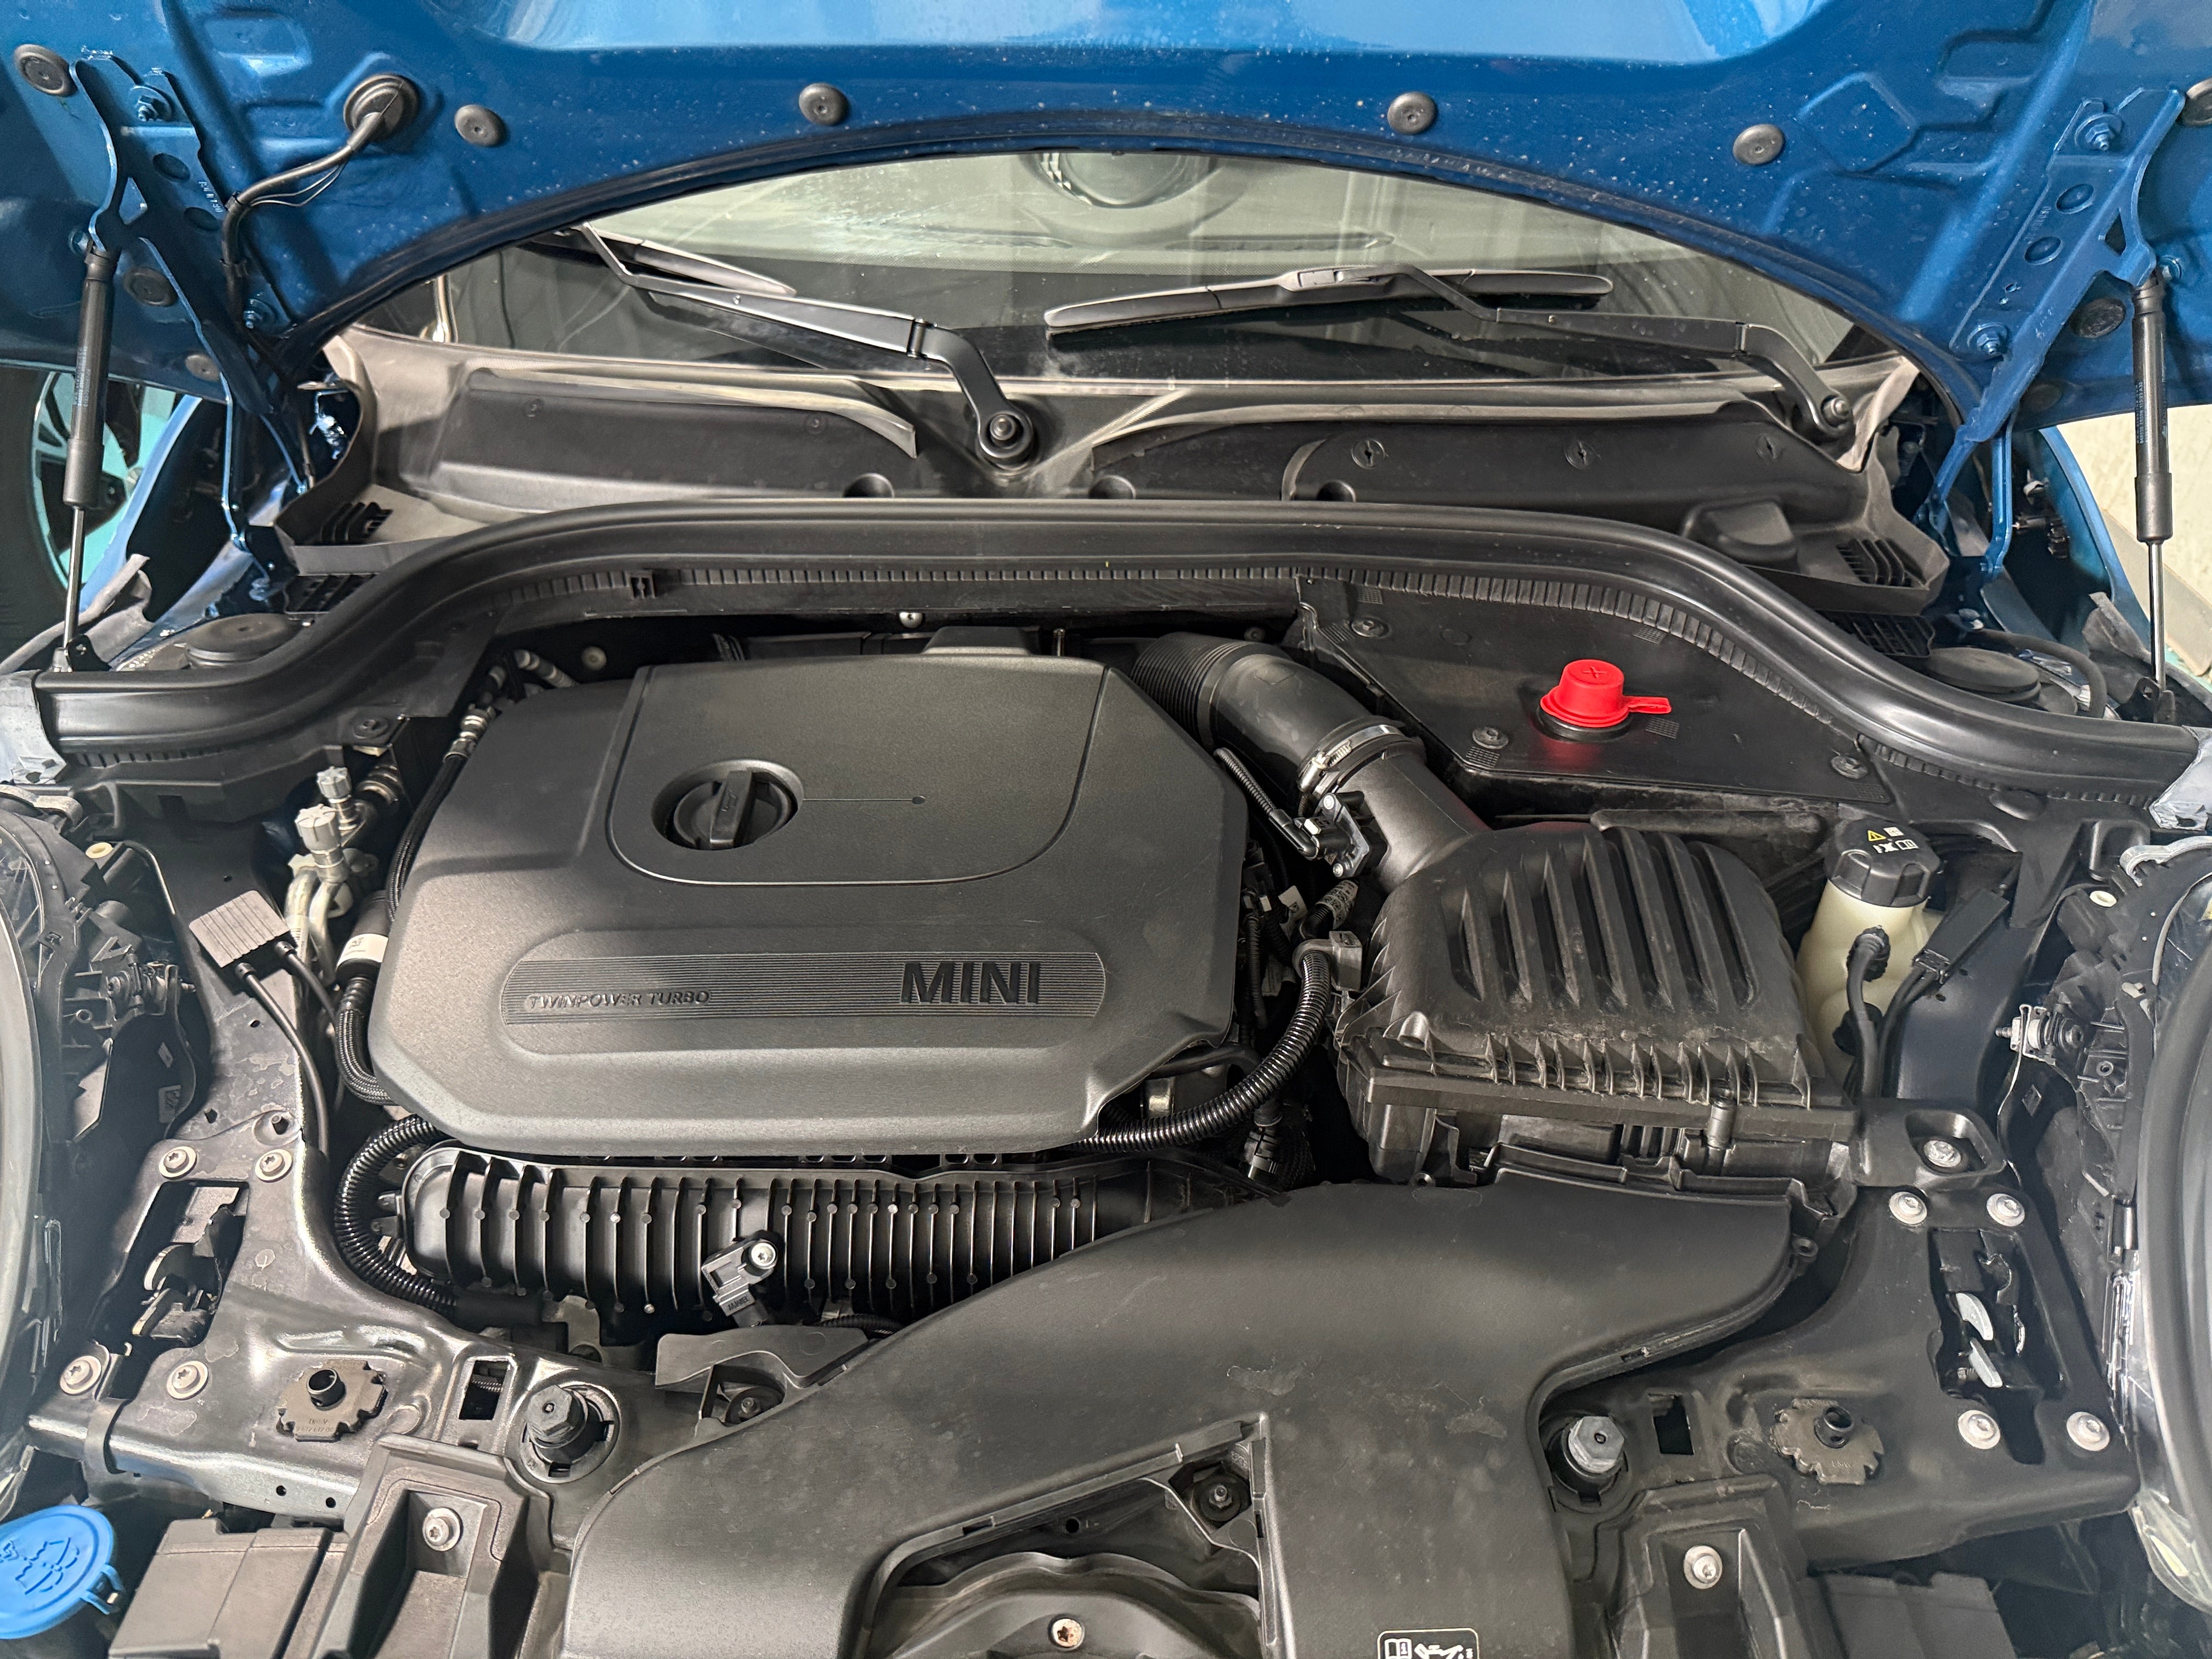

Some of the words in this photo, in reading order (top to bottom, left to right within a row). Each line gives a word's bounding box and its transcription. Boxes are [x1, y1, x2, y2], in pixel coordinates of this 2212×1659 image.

[900, 962, 1040, 1003] MINI
[529, 993, 642, 1009] TWINPOWER
[647, 990, 710, 1005] TURBO
[728, 1296, 748, 1311] BMW
